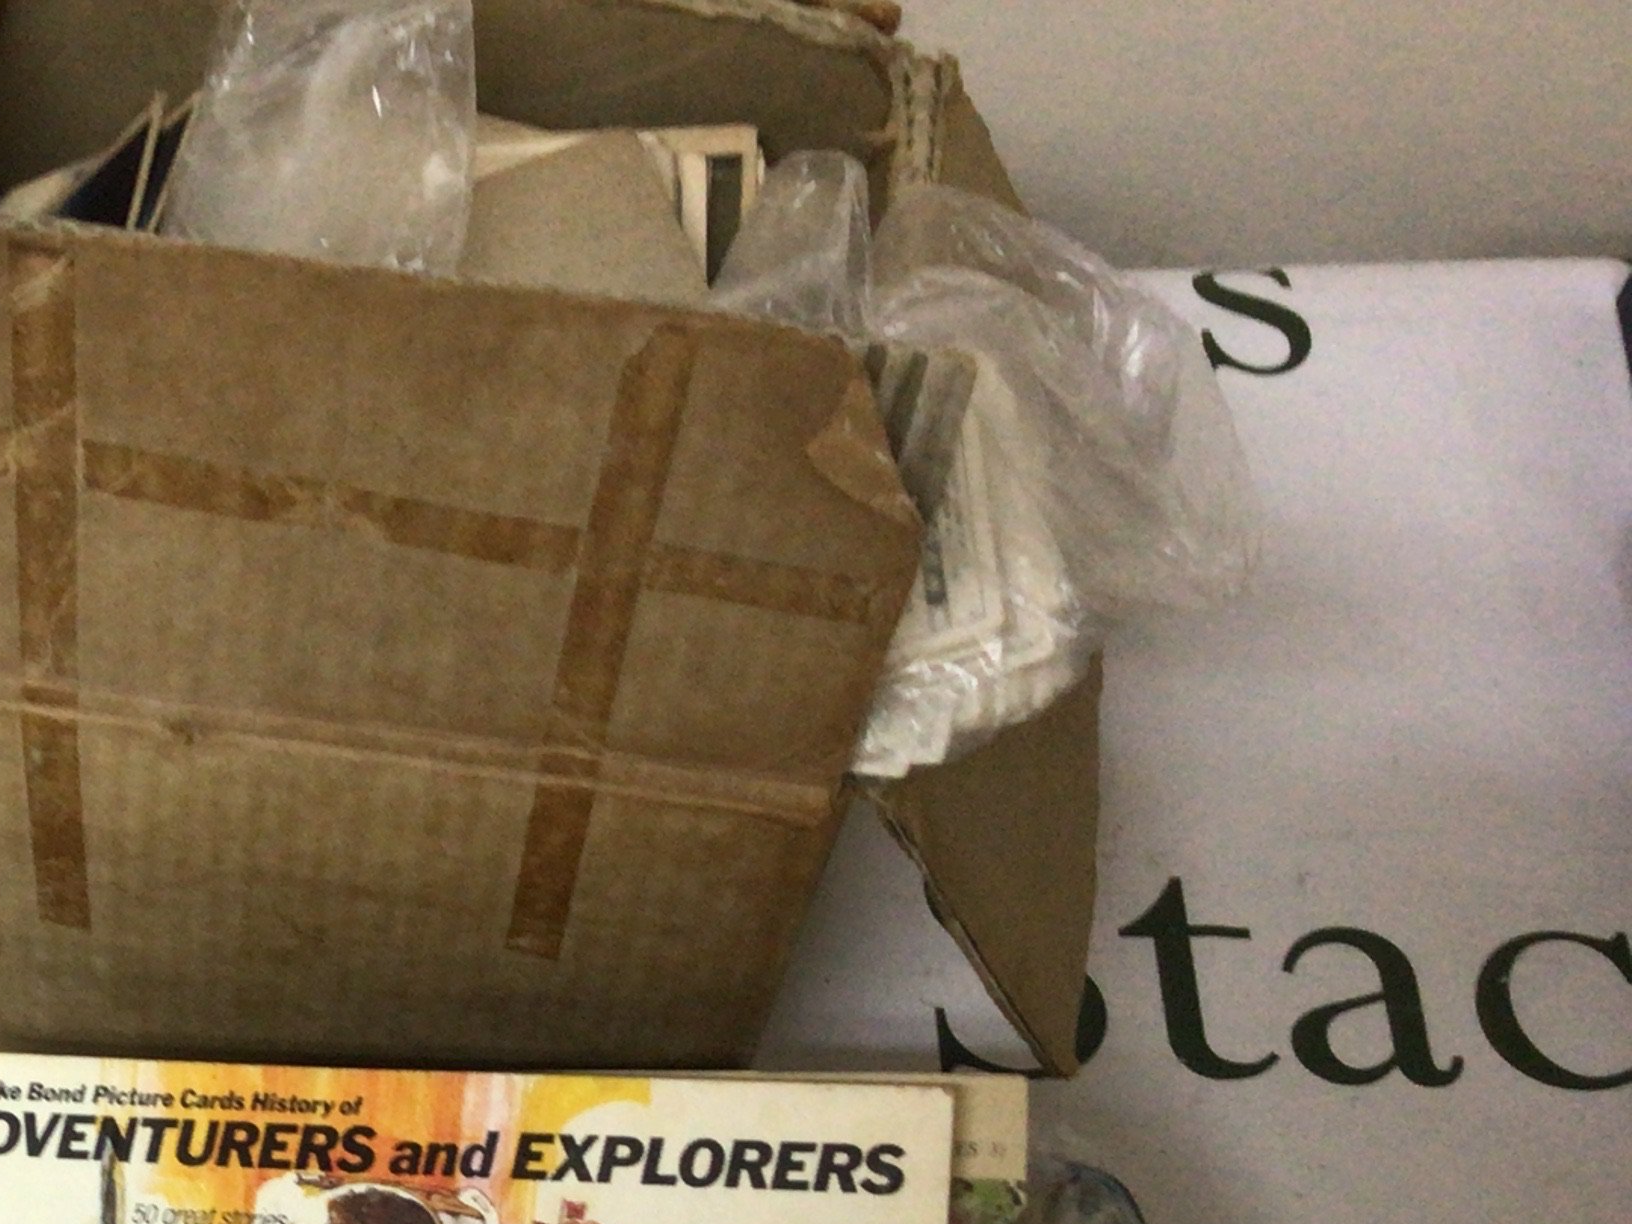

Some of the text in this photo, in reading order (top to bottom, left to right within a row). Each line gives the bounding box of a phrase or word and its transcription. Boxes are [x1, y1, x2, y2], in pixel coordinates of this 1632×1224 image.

[27, 1081, 87, 1105] Bond
[92, 1085, 174, 1109] Picture
[179, 1088, 246, 1111] Cards
[251, 1091, 335, 1117] History
[339, 1095, 364, 1115] of
[389, 1130, 499, 1179] and
[509, 1132, 907, 1197] EXPLORERS
